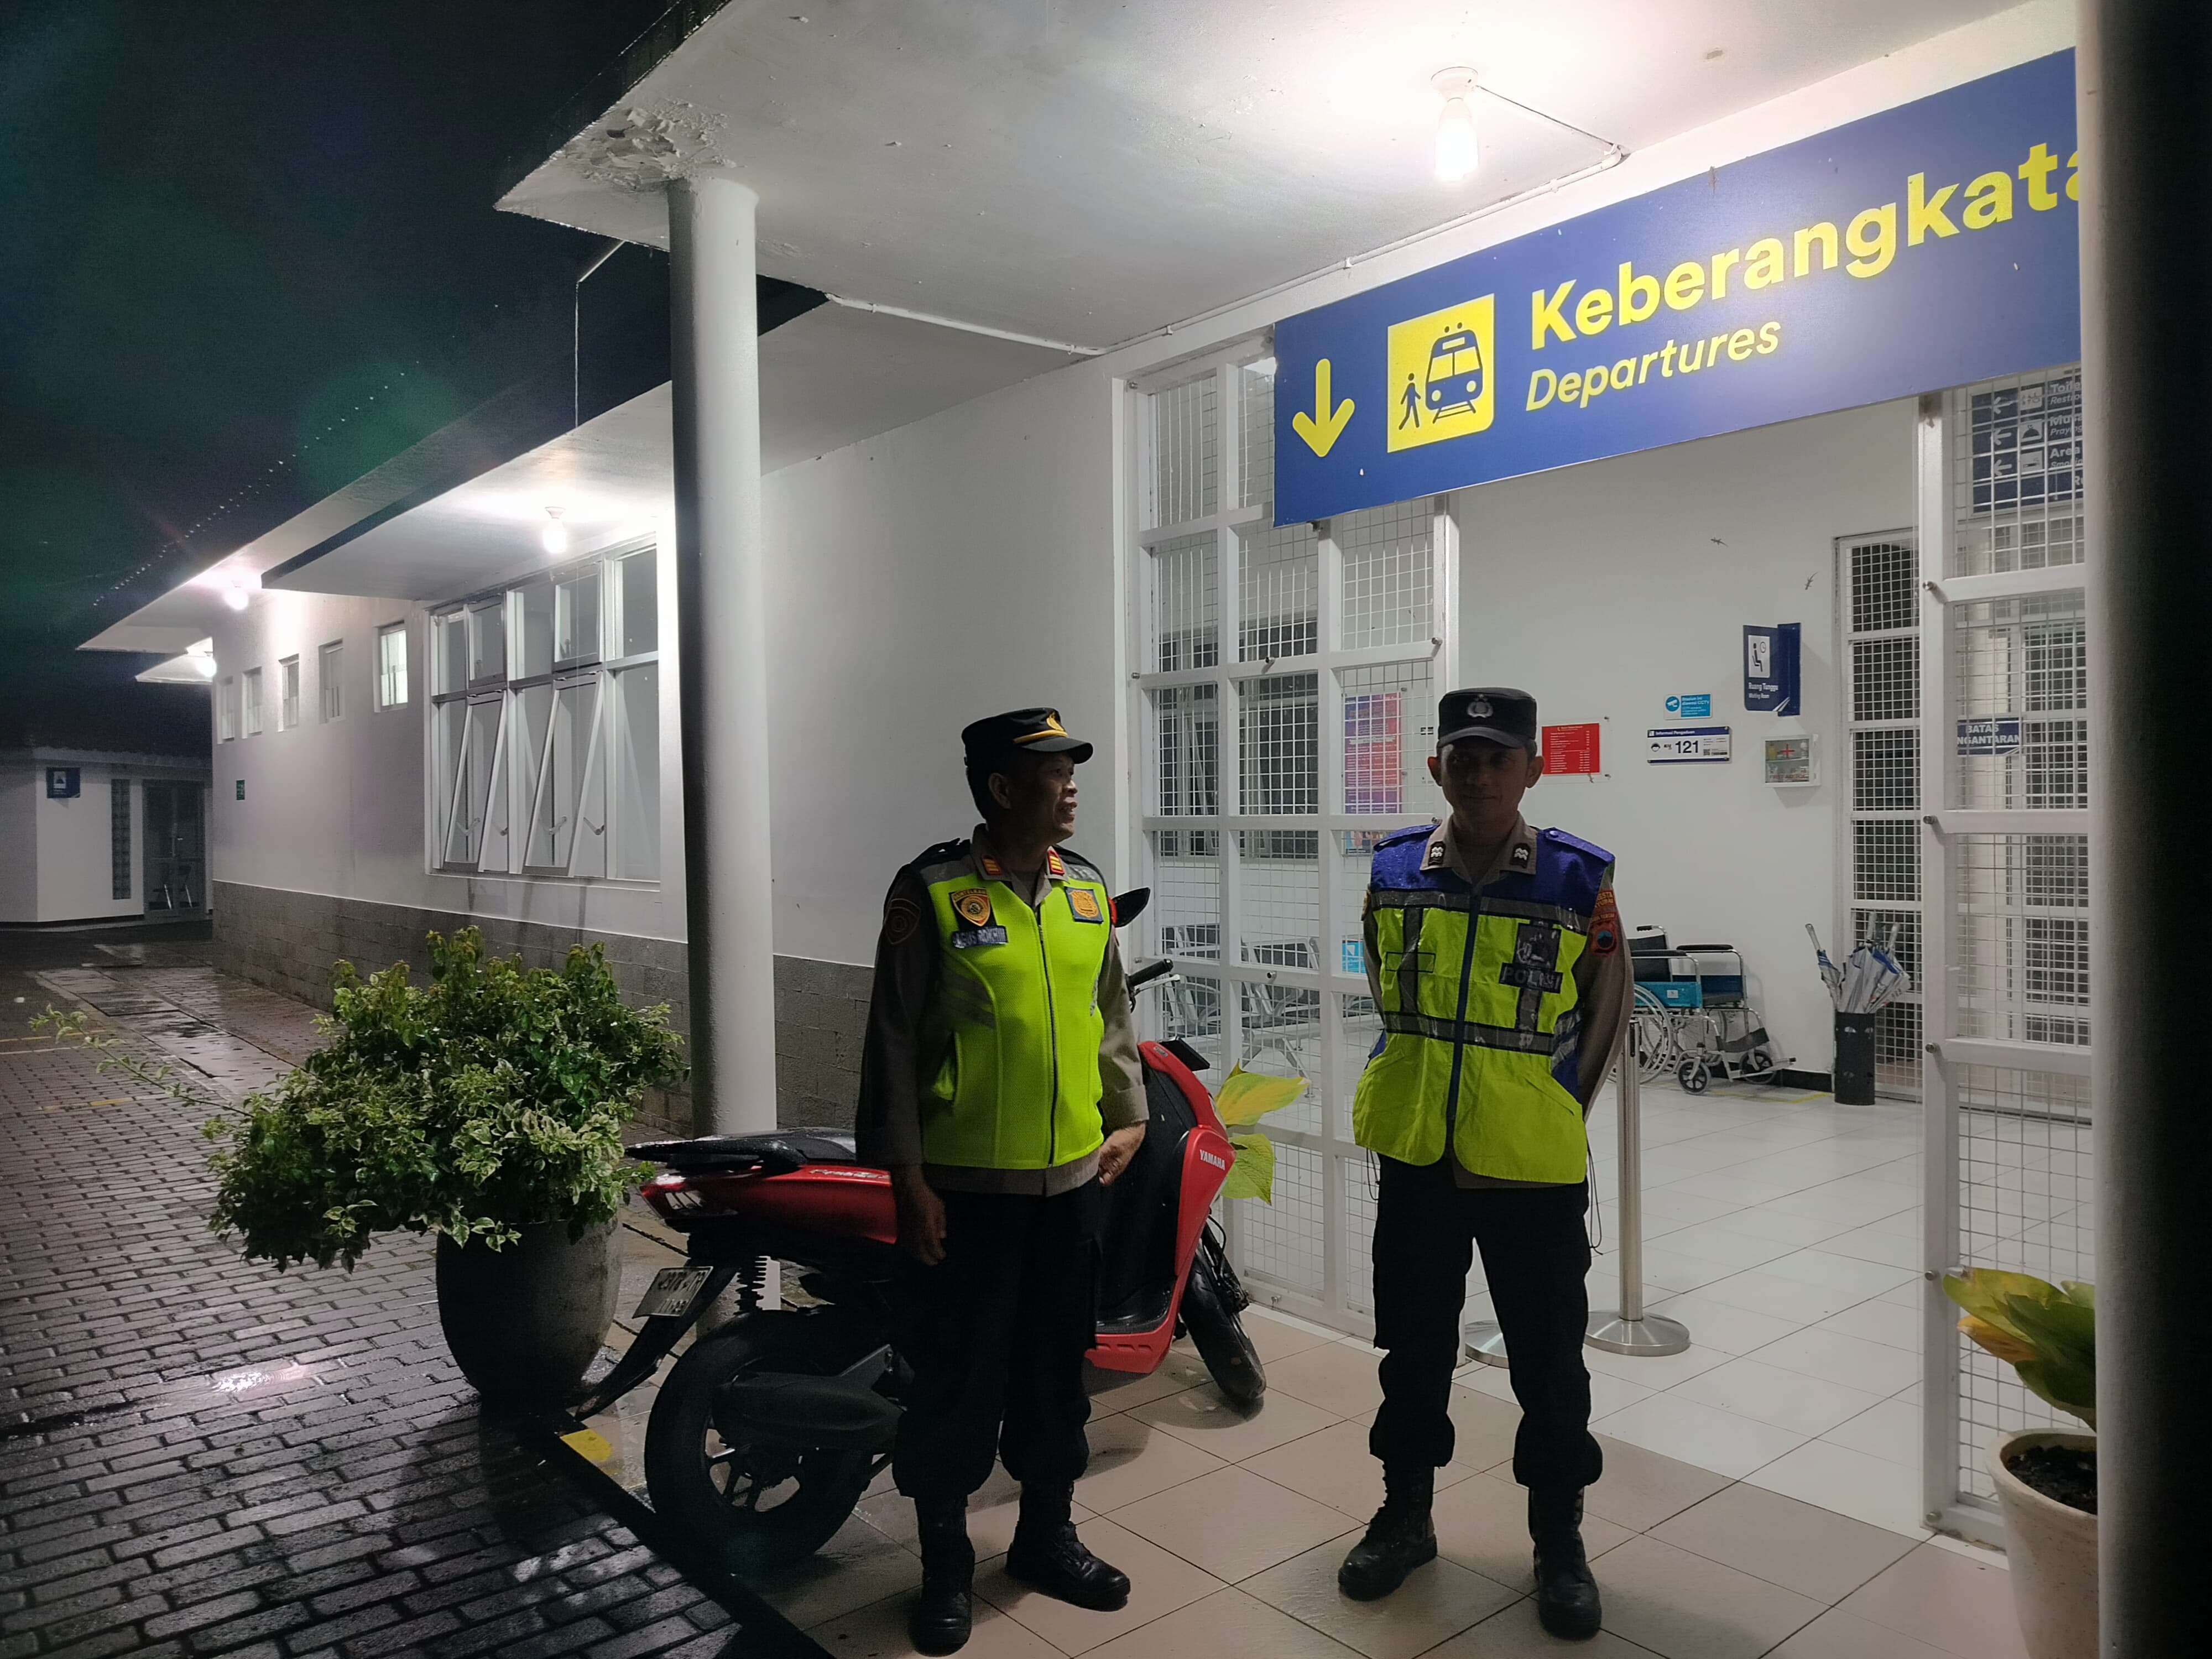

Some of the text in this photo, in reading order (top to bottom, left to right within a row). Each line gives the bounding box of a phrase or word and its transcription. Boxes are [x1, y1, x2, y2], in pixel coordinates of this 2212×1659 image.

[1526, 321, 1781, 411] Departures
[2050, 446, 2080, 458] Area
[1966, 724, 1999, 733] BATAS
[1958, 734, 2019, 745] NGANTARAN
[1675, 740, 1698, 754] 121
[1500, 966, 1561, 990] POLISI
[1199, 1149, 1226, 1171] YAMAHA
